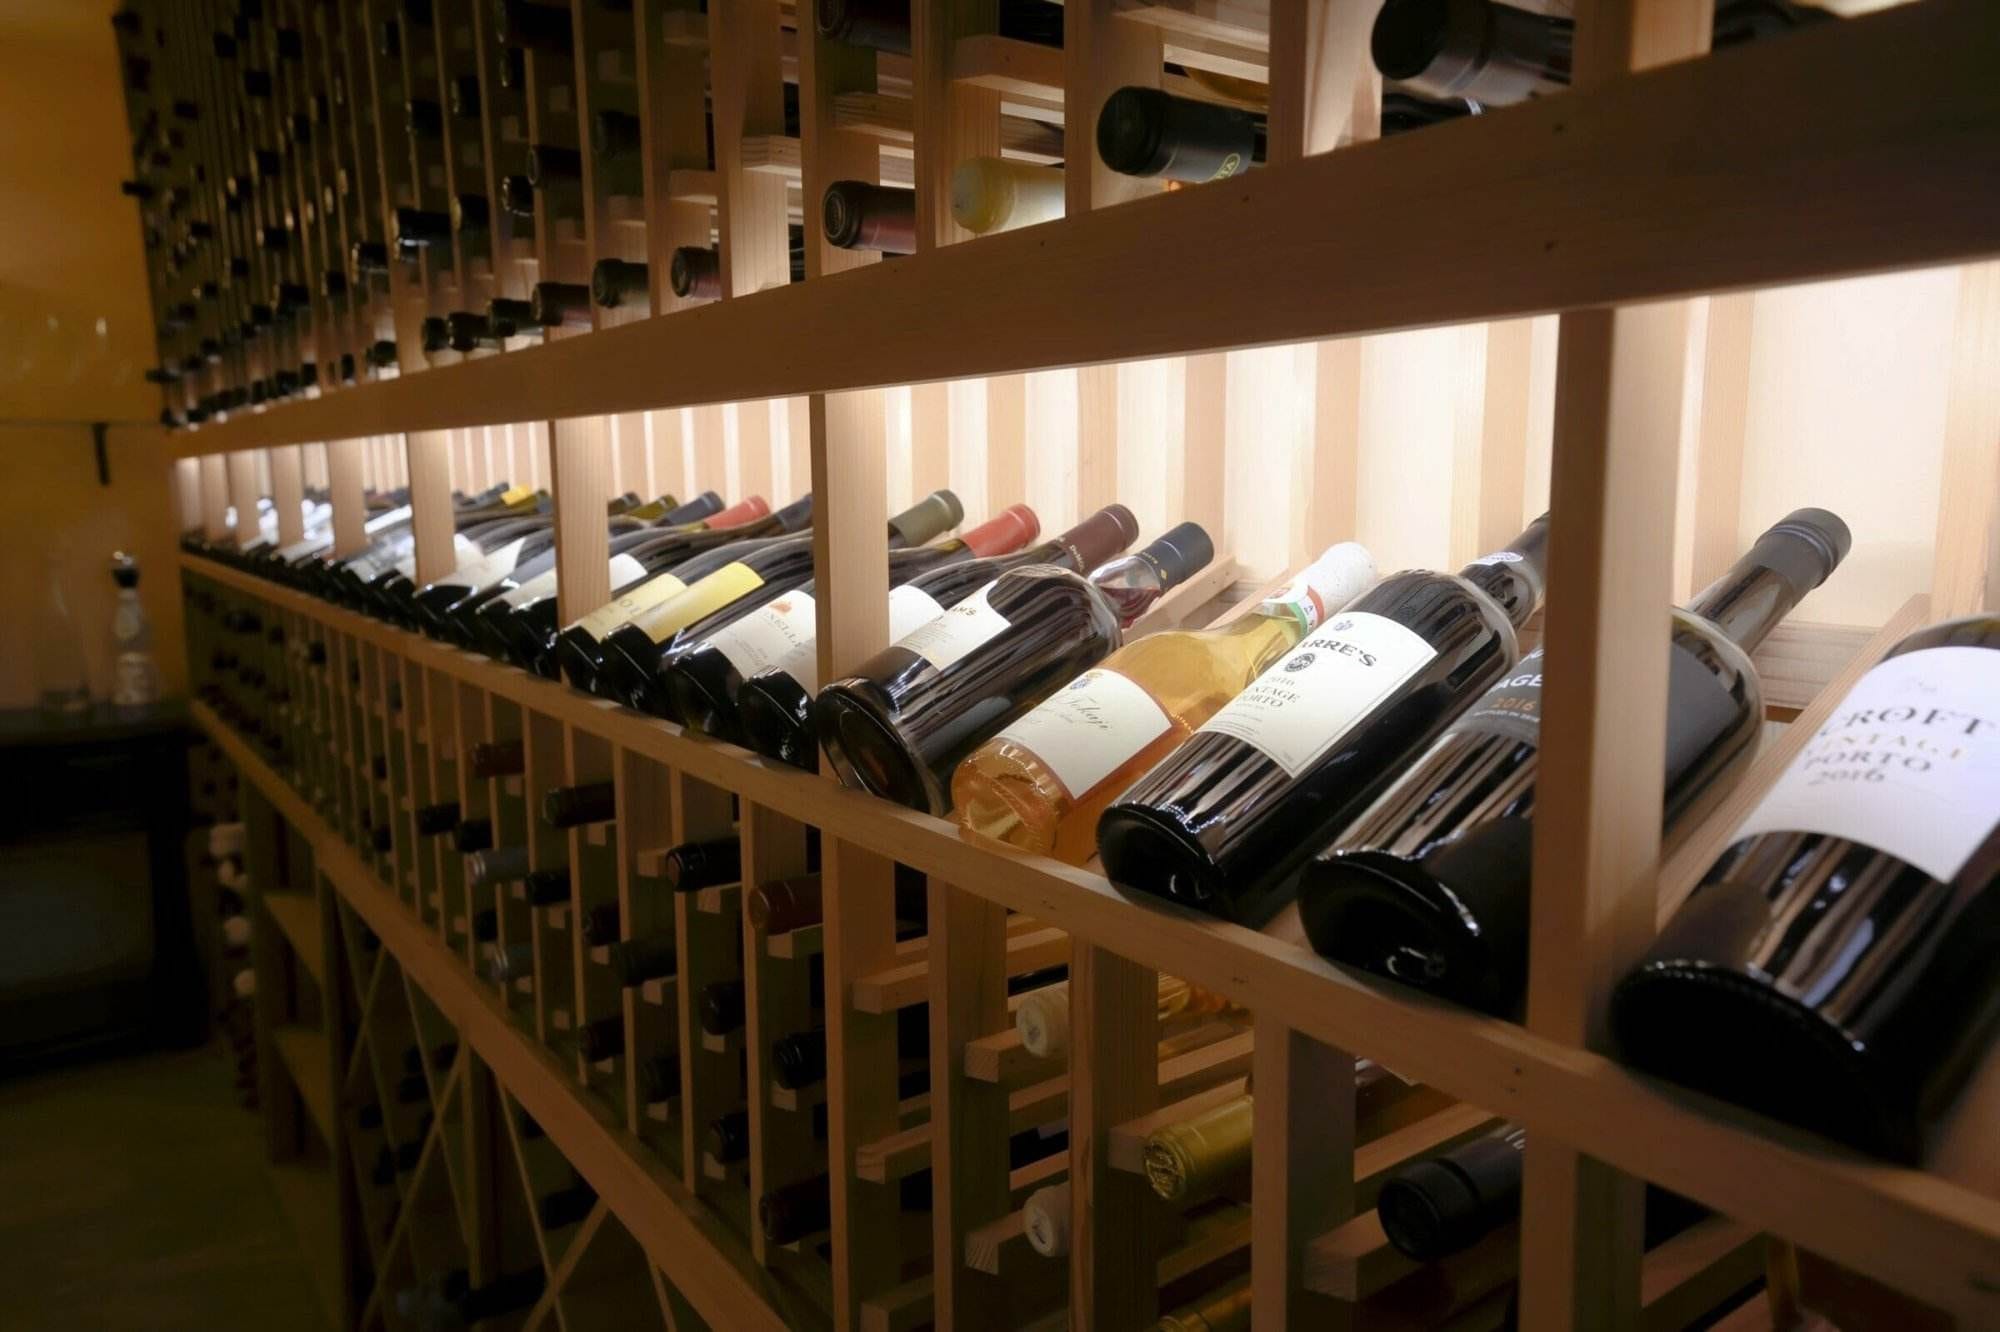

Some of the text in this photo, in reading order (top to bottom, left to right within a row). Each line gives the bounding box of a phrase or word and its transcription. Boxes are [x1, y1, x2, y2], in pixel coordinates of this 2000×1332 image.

[1302, 638, 1377, 667] RRE'S
[1488, 697, 1538, 711] 2016
[1807, 767, 1886, 787] 2016
